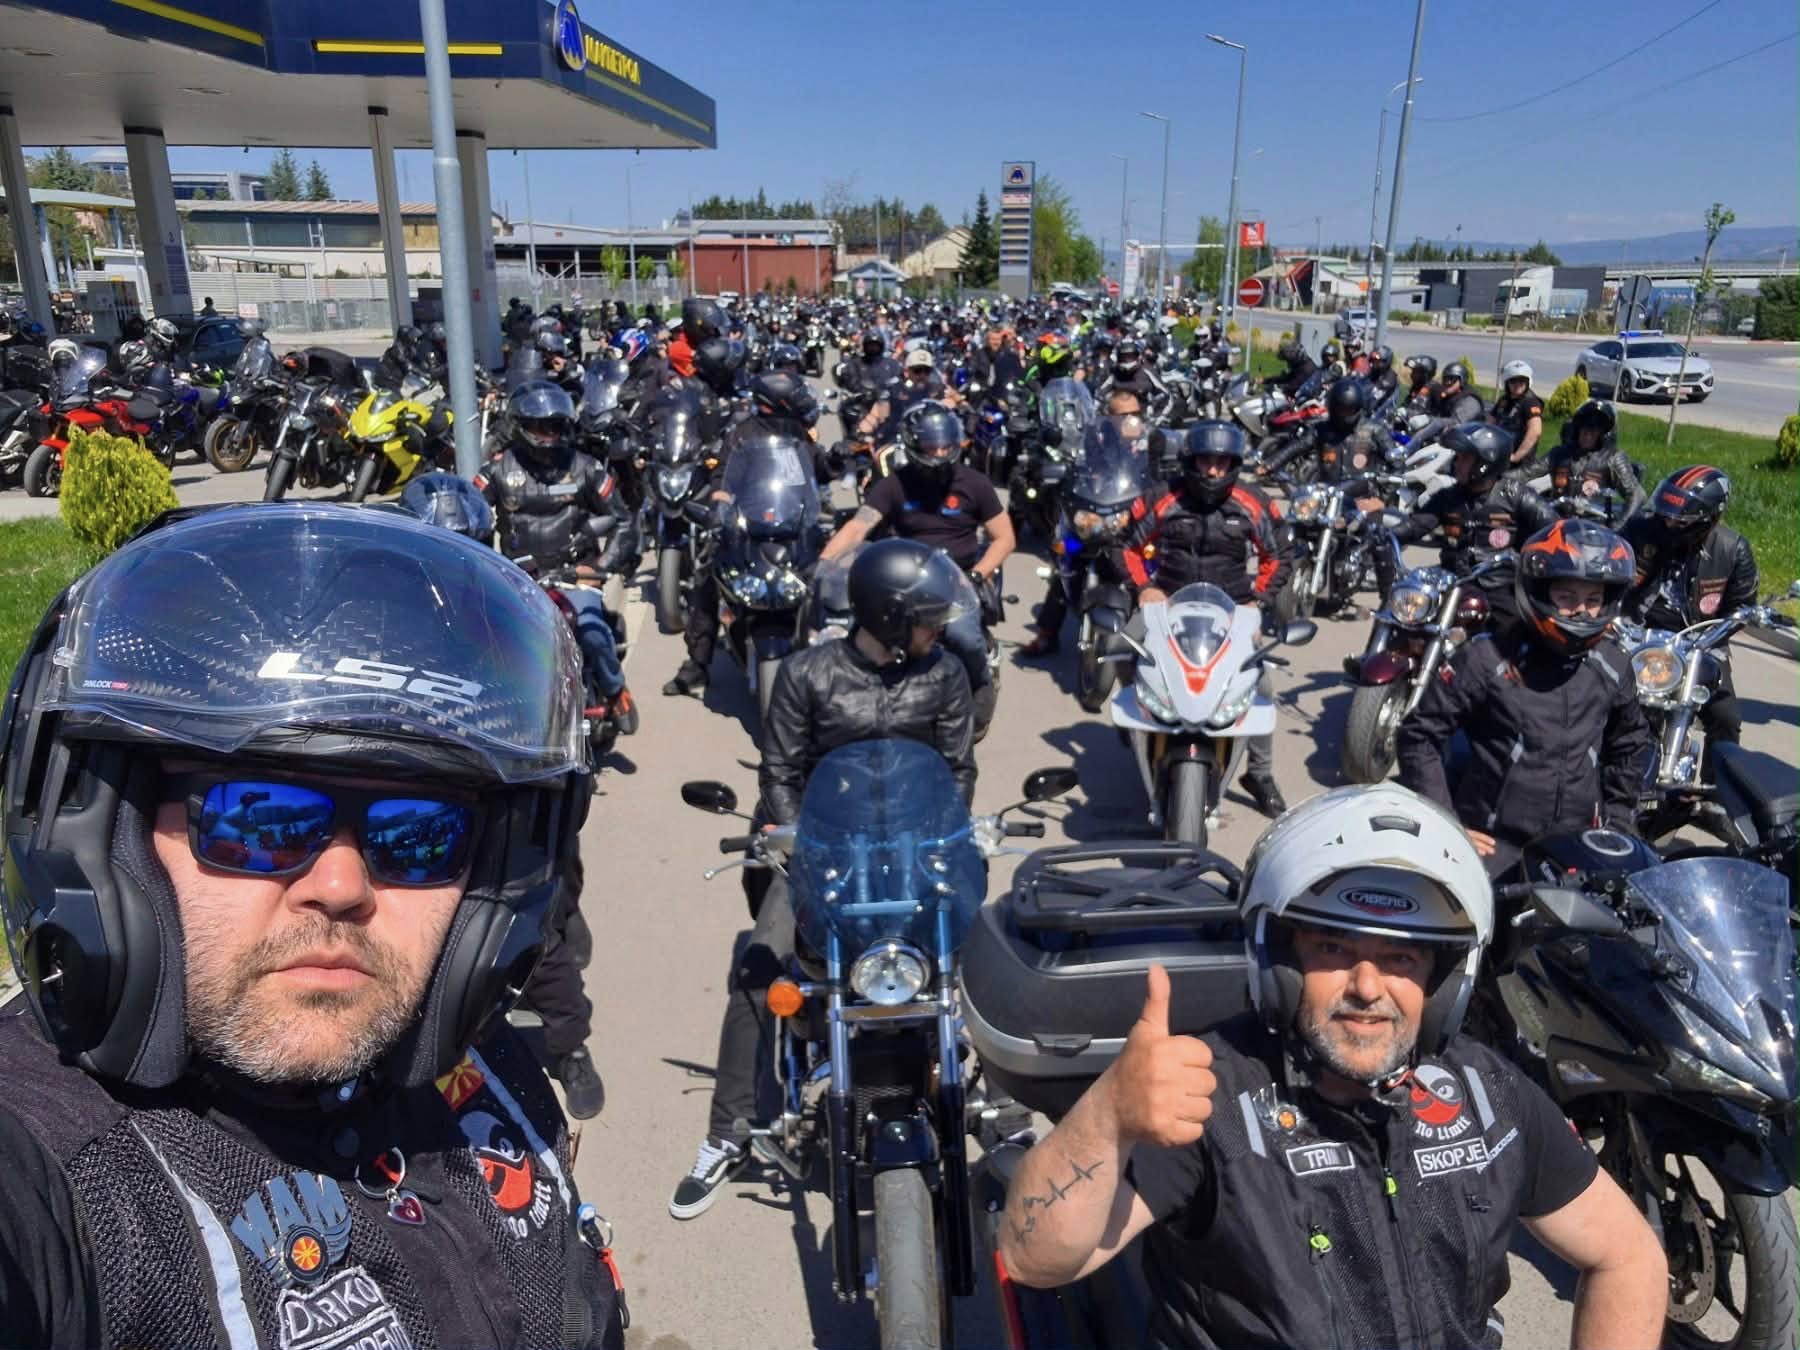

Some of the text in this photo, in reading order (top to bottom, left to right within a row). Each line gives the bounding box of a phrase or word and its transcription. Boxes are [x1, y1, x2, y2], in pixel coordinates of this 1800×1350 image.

[257, 651, 483, 705] LS2
[1421, 1143, 1485, 1171] SKOPJE
[285, 1277, 379, 1341] DARKO
